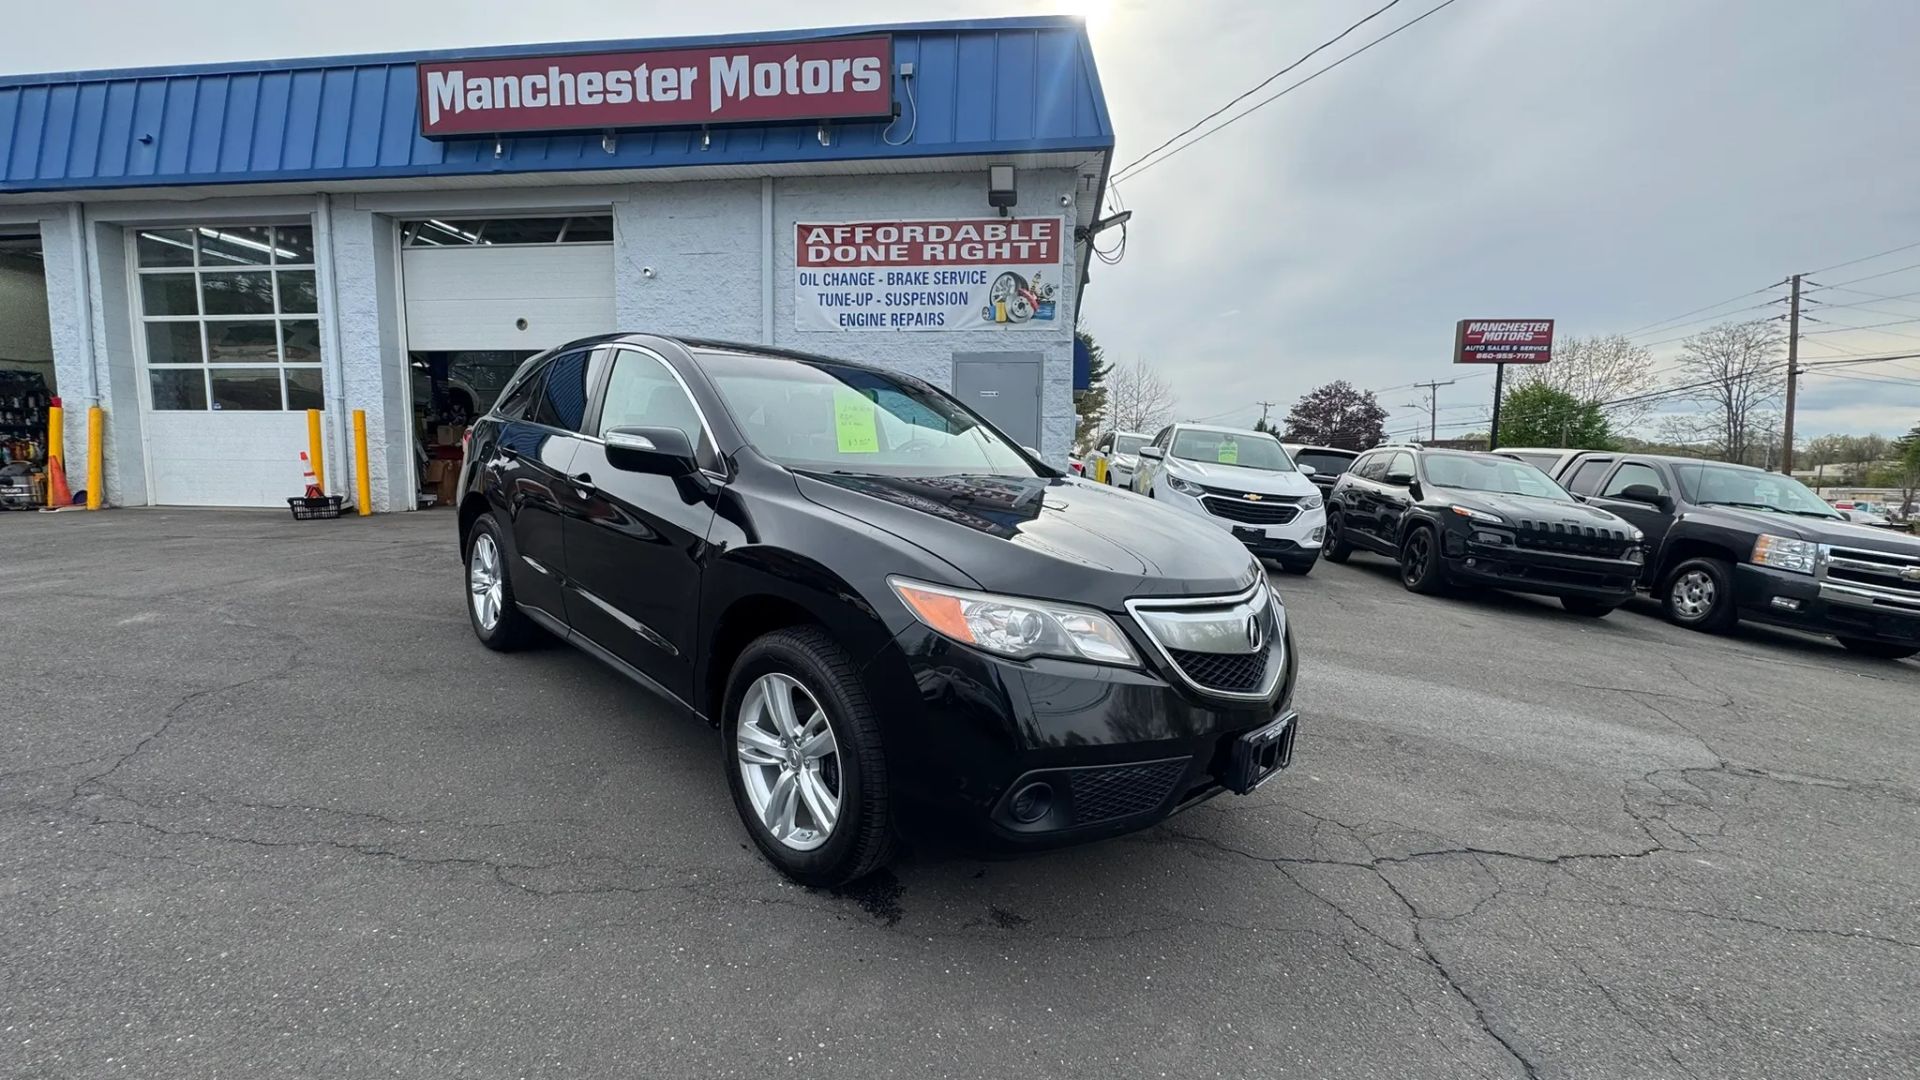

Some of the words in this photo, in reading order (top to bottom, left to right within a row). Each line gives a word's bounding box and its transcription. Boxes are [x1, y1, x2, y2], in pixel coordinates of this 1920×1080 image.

[427, 62, 698, 126] Manchester
[709, 54, 881, 113] Motors
[805, 223, 1052, 245] AFFORDABLE
[808, 244, 909, 263] DONE
[922, 241, 1048, 261] RIGHT!
[799, 272, 819, 287] OIL
[823, 272, 875, 286] CHANGE
[887, 271, 929, 286] BRAKE
[933, 270, 987, 285] SERVICE
[818, 292, 873, 307] TUNE-UP
[885, 291, 968, 306] SUSPENSION
[839, 312, 886, 327] ENGINE
[890, 312, 944, 326] REPAIRS
[1467, 322, 1550, 334] MANCHESTER
[1481, 331, 1534, 343] MOTORS
